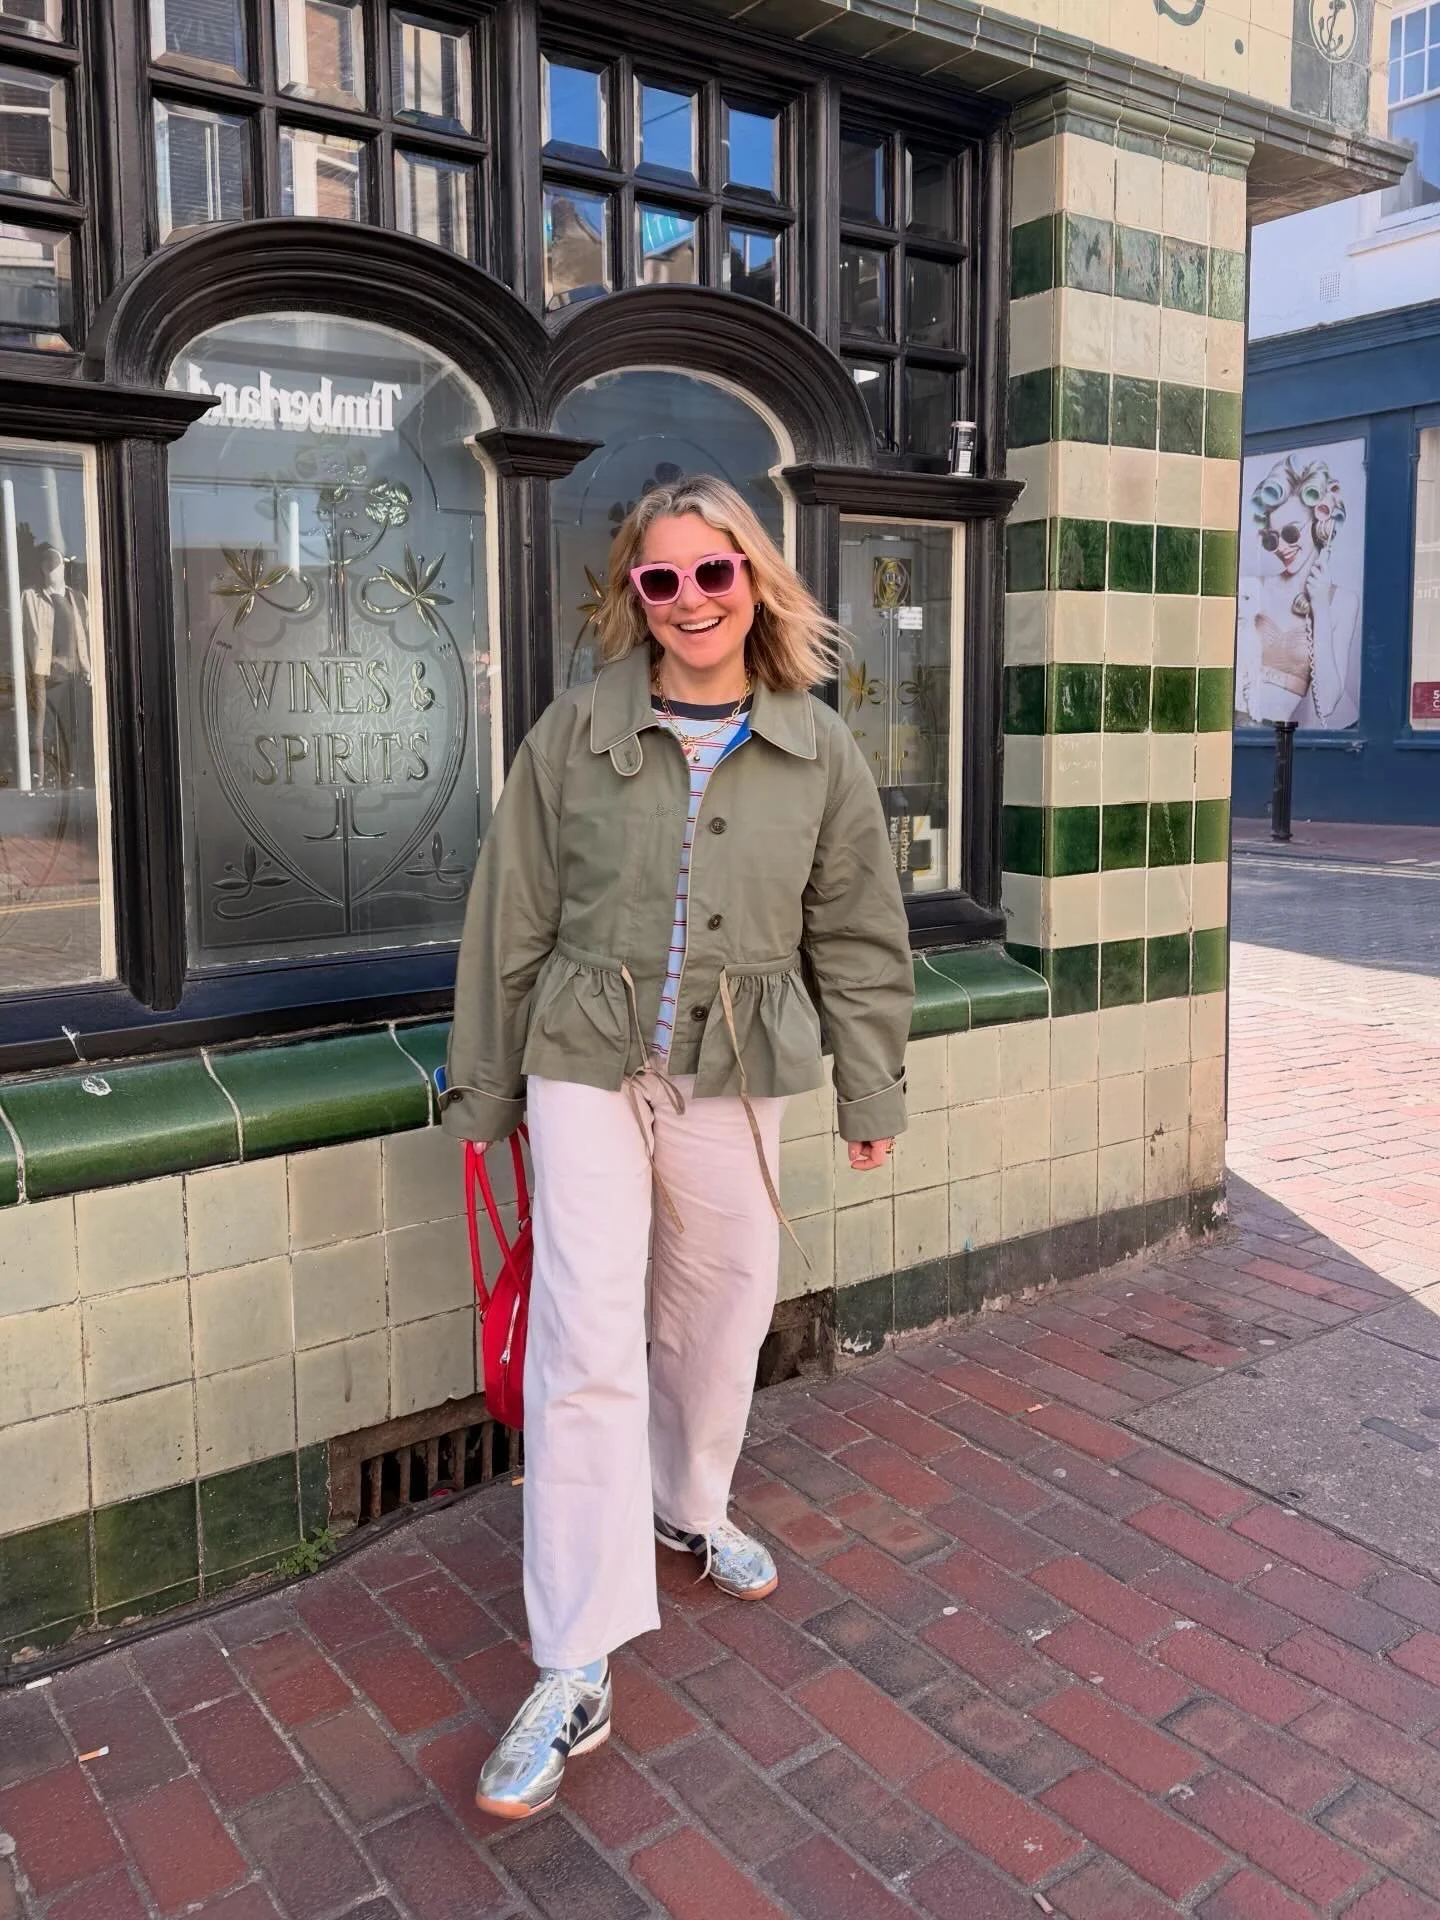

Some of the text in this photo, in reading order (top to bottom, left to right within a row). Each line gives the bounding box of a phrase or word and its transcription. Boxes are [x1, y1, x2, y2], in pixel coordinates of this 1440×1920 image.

[236, 660, 444, 713] WINES &
[253, 729, 428, 785] SPIRITS
